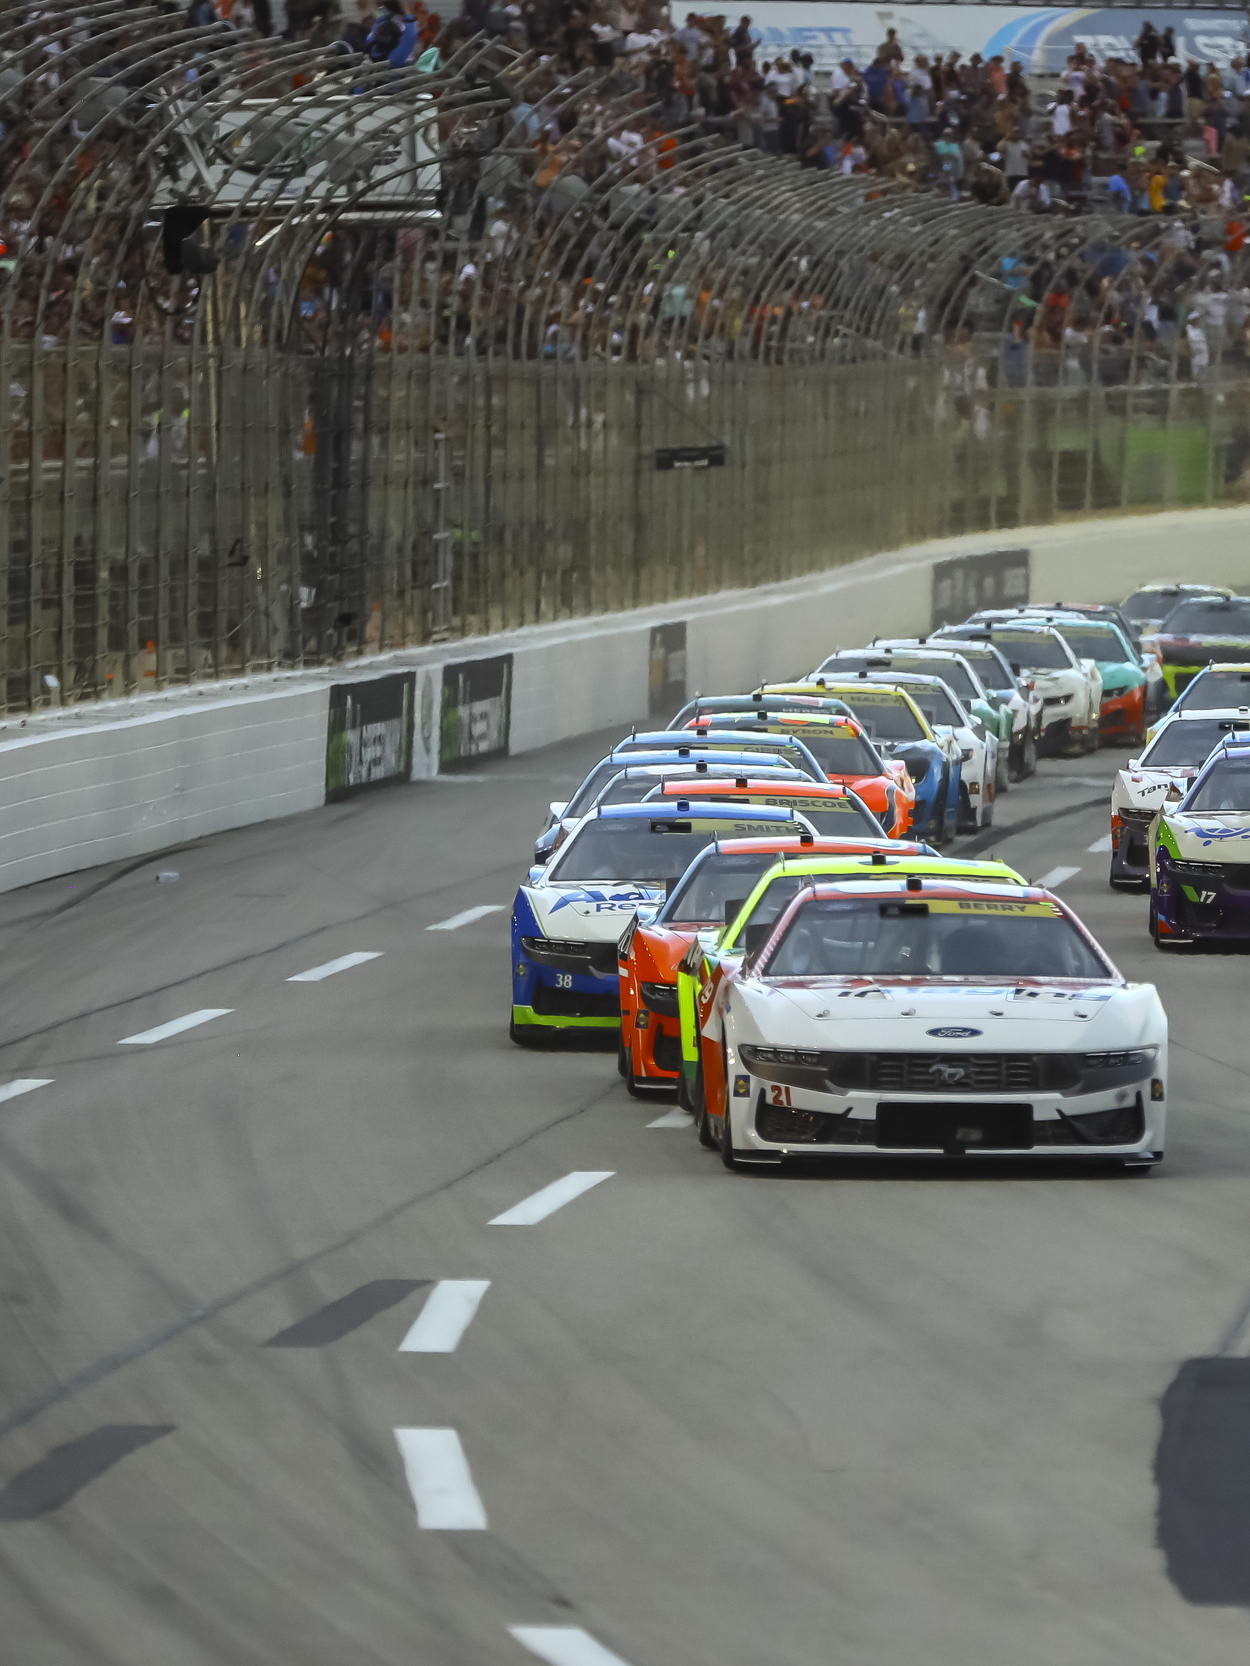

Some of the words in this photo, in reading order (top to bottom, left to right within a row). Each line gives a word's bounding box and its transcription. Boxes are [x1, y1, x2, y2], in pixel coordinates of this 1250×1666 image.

[780, 728, 834, 736] BYRON
[765, 798, 850, 809] BRISCOE
[1200, 890, 1216, 904] 17
[958, 902, 1027, 912] BERRY
[555, 973, 573, 988] 38
[771, 1085, 792, 1107] 21
